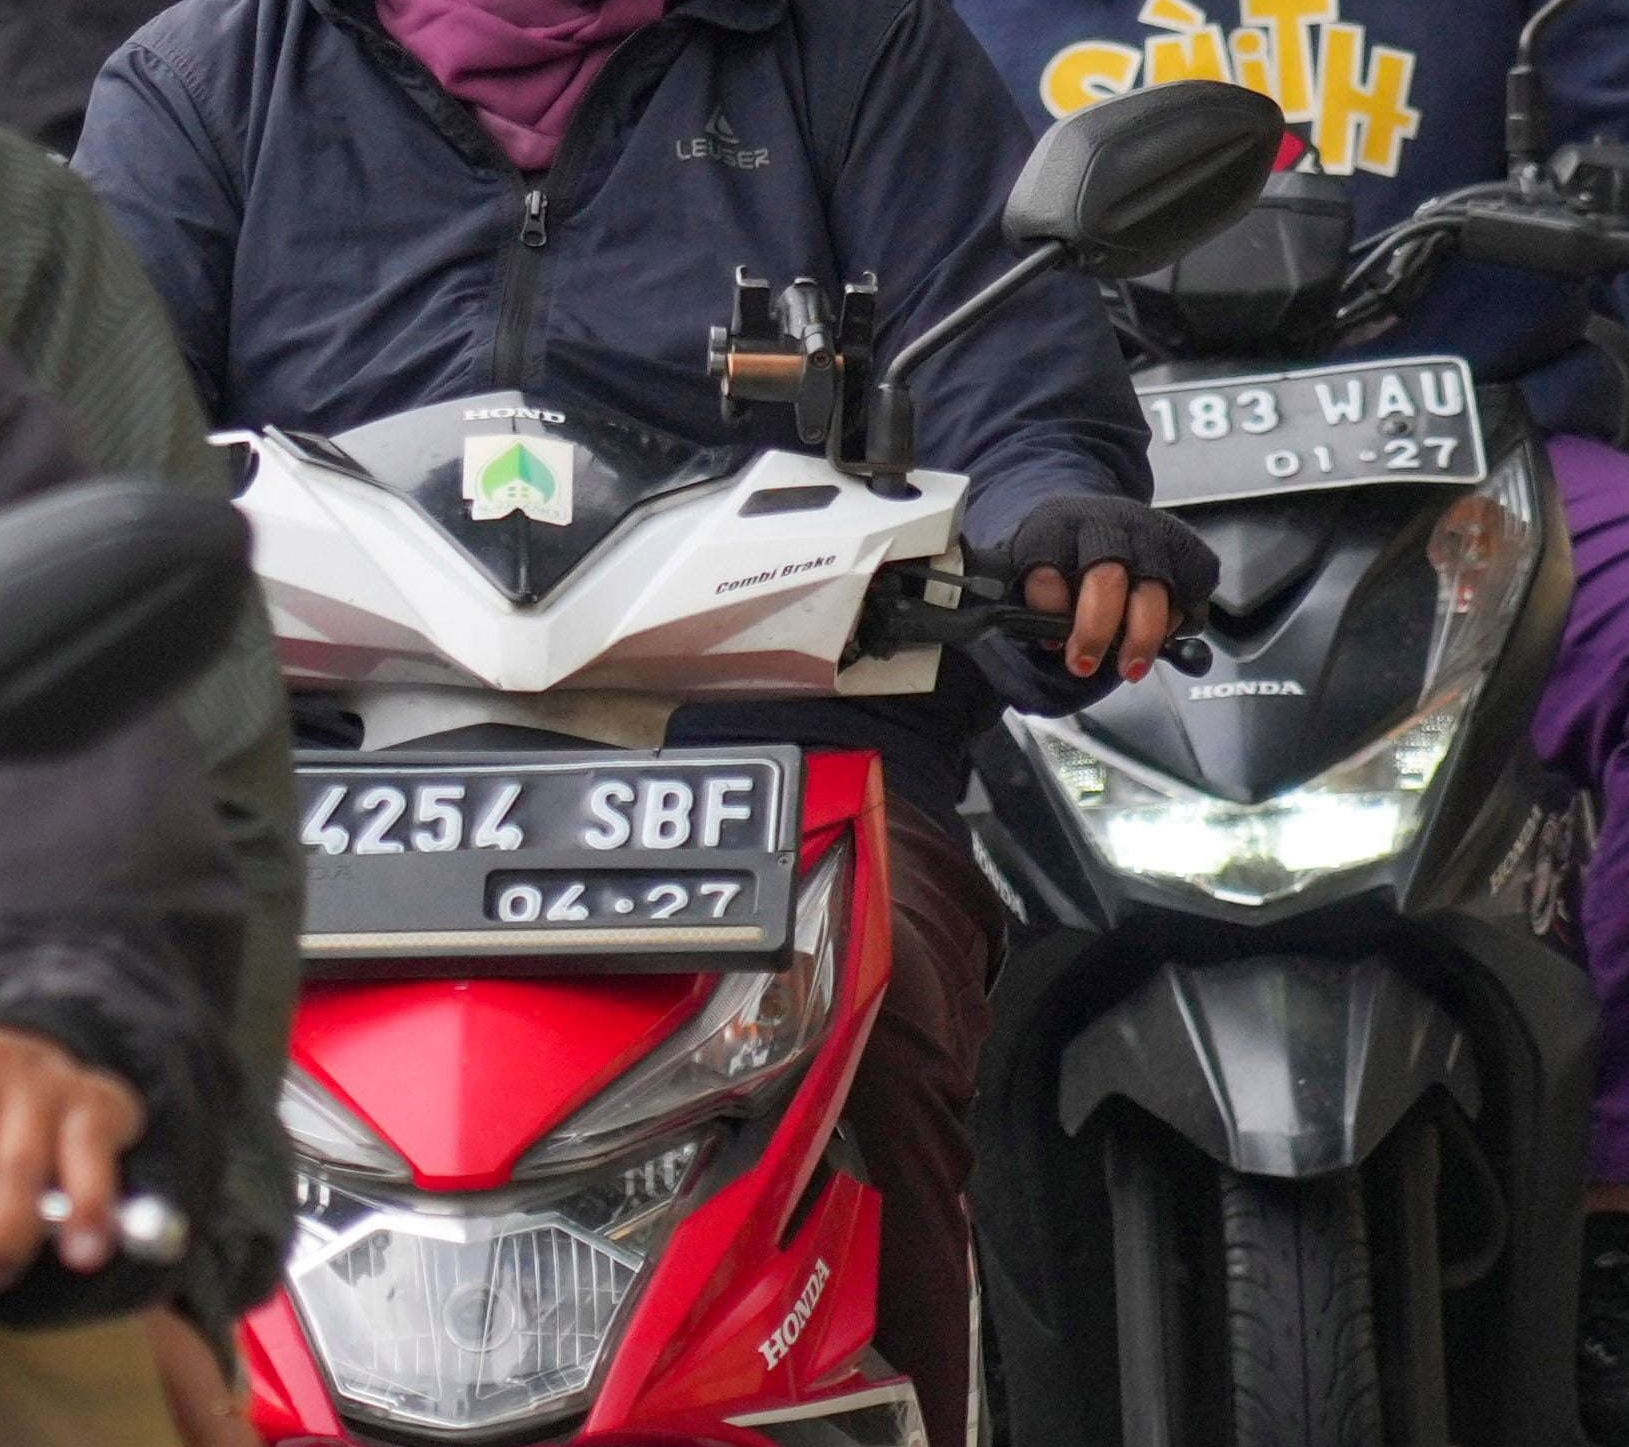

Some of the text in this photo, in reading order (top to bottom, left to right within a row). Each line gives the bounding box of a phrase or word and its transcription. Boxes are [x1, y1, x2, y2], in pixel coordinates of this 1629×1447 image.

[1150, 369, 1463, 444] 183 WAU
[715, 553, 837, 595] Combi Brake
[1188, 678, 1305, 702] HONDA
[300, 776, 754, 855] 4254 SBF
[757, 1257, 831, 1372] HONDA
